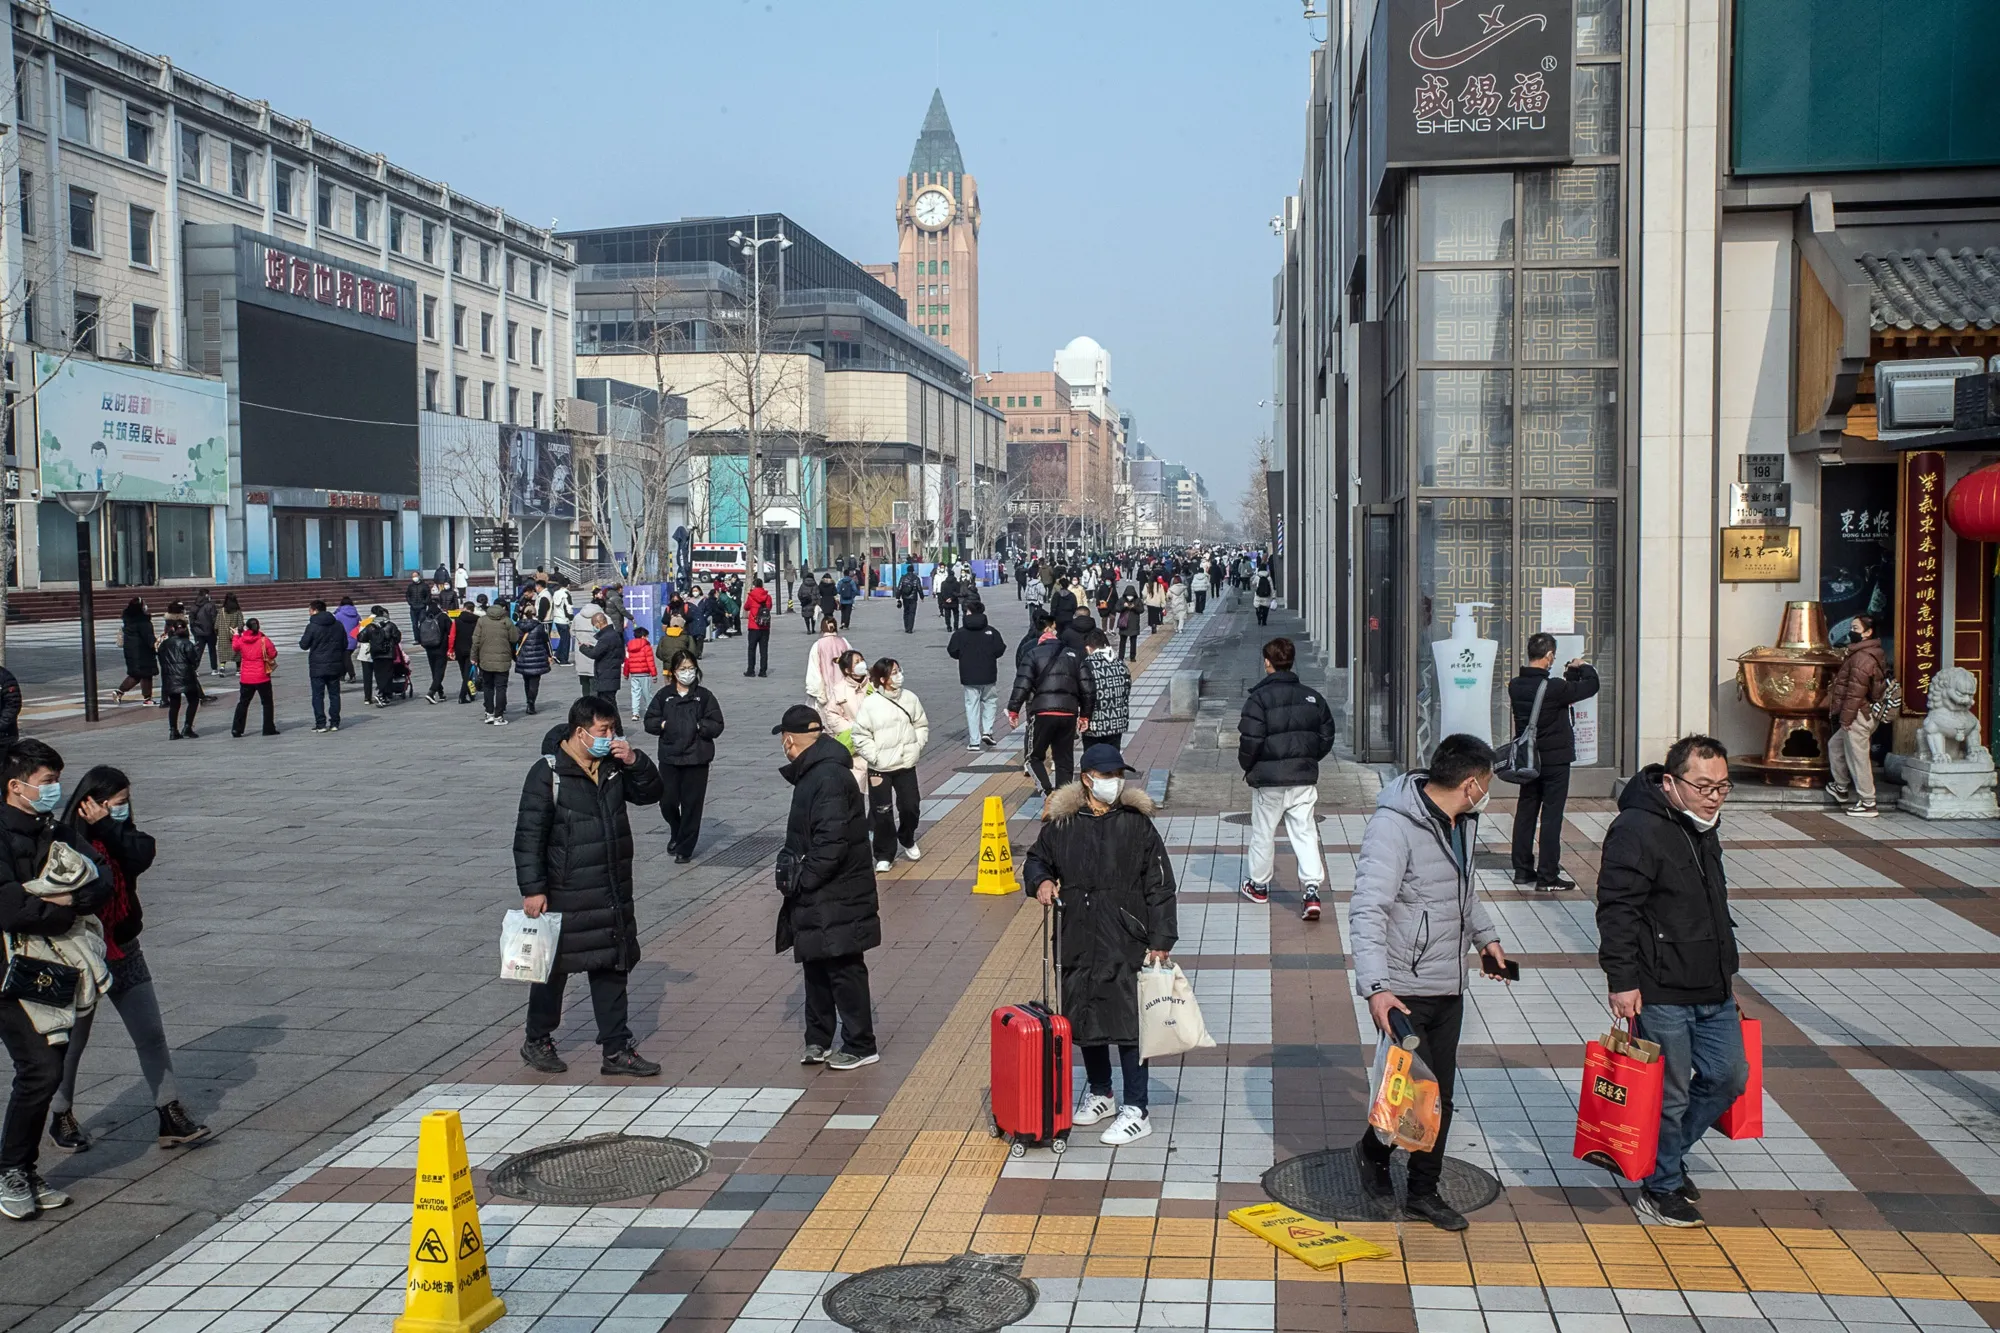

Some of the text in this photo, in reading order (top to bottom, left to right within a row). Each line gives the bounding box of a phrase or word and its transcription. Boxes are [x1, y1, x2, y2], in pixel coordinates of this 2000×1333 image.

[1416, 116, 1546, 134] SHENG XIFU
[265, 247, 397, 321] 好友世界商场
[1753, 466, 1771, 478] 198
[1740, 493, 1783, 502] 营业时间
[1145, 997, 1161, 1010] JILIN
[419, 1197, 445, 1205] CAUTION
[454, 1190, 471, 1202] CAUTION
[458, 1264, 487, 1291] 小心地滑
[409, 1278, 454, 1294] 小心地滑
